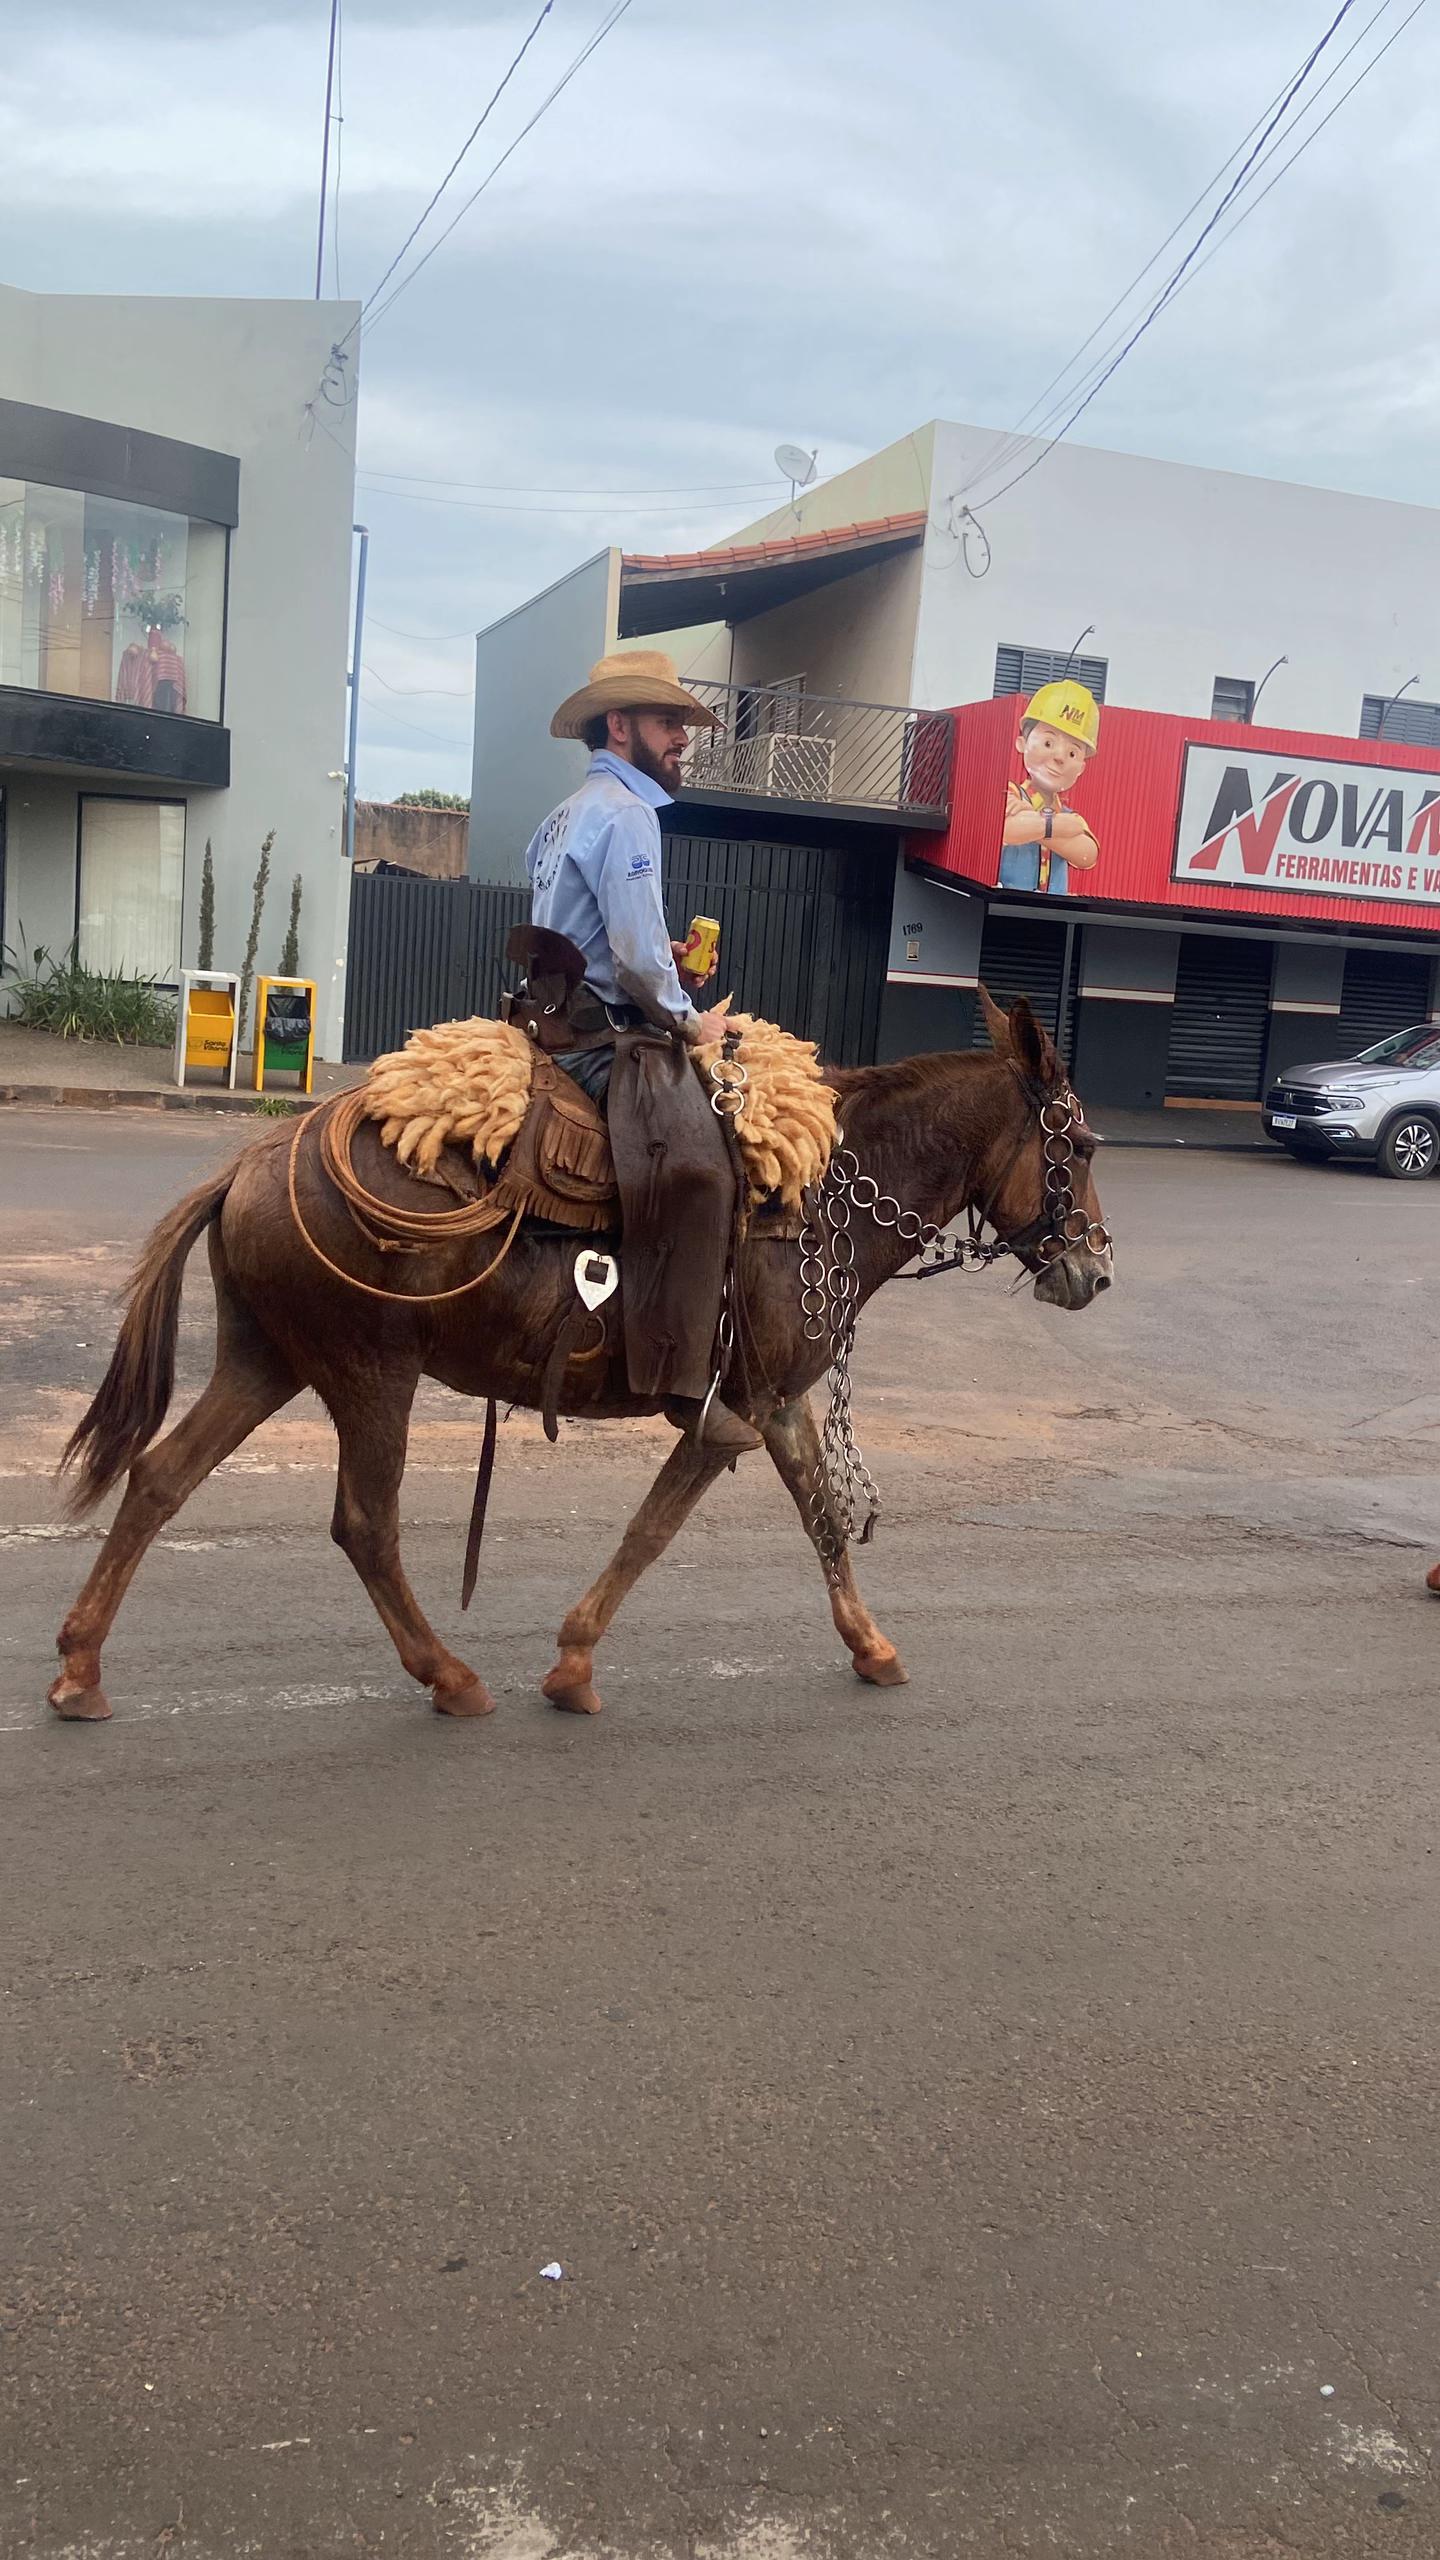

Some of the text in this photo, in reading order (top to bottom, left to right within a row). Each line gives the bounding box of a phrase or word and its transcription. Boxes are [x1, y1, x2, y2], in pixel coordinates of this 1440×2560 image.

[1275, 853, 1402, 889] FERRAMENTAS
[1407, 867, 1418, 890] E
[902, 922, 923, 936] 1769
